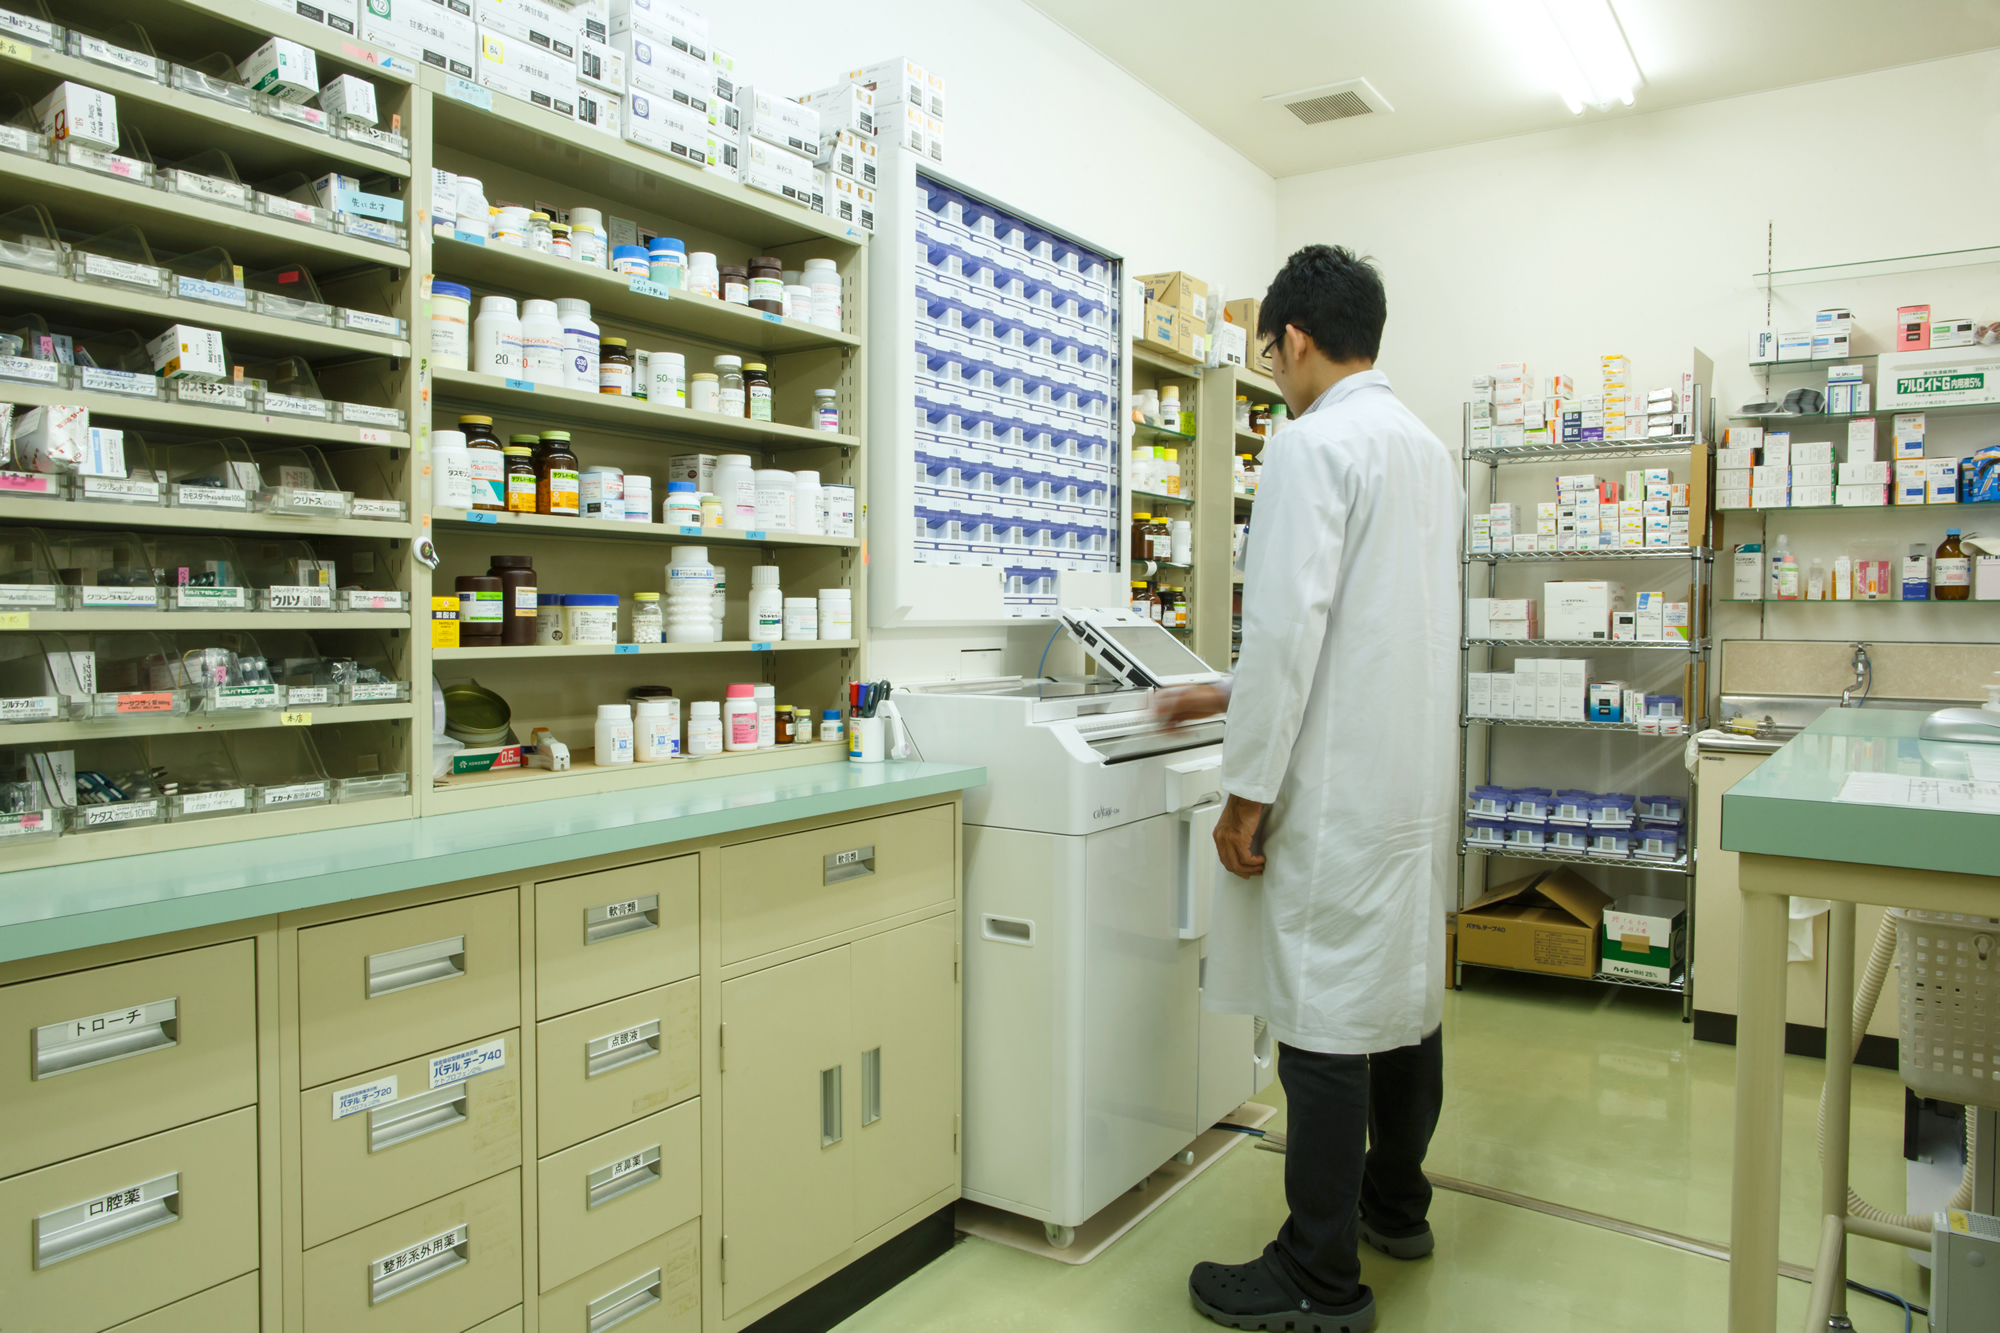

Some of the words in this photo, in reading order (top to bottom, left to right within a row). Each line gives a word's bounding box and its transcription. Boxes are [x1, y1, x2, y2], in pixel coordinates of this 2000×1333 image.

[366, 52, 374, 62] A
[489, 45, 499, 56] 84
[351, 197, 386, 212] 先に出す
[461, 233, 471, 242] ア
[475, 513, 483, 521] タ
[287, 713, 303, 723] 本店
[501, 750, 520, 764] 0.5mg
[608, 901, 637, 916] 軟膏類
[78, 1009, 141, 1036] トローチ
[611, 1030, 639, 1048] 点眼液
[433, 1061, 460, 1078] パテル
[463, 1049, 502, 1068] テープ40
[614, 1155, 642, 1174] 点鼻薬
[90, 1188, 141, 1216] 口腔薬
[383, 1233, 456, 1275] 整形系外用薬
